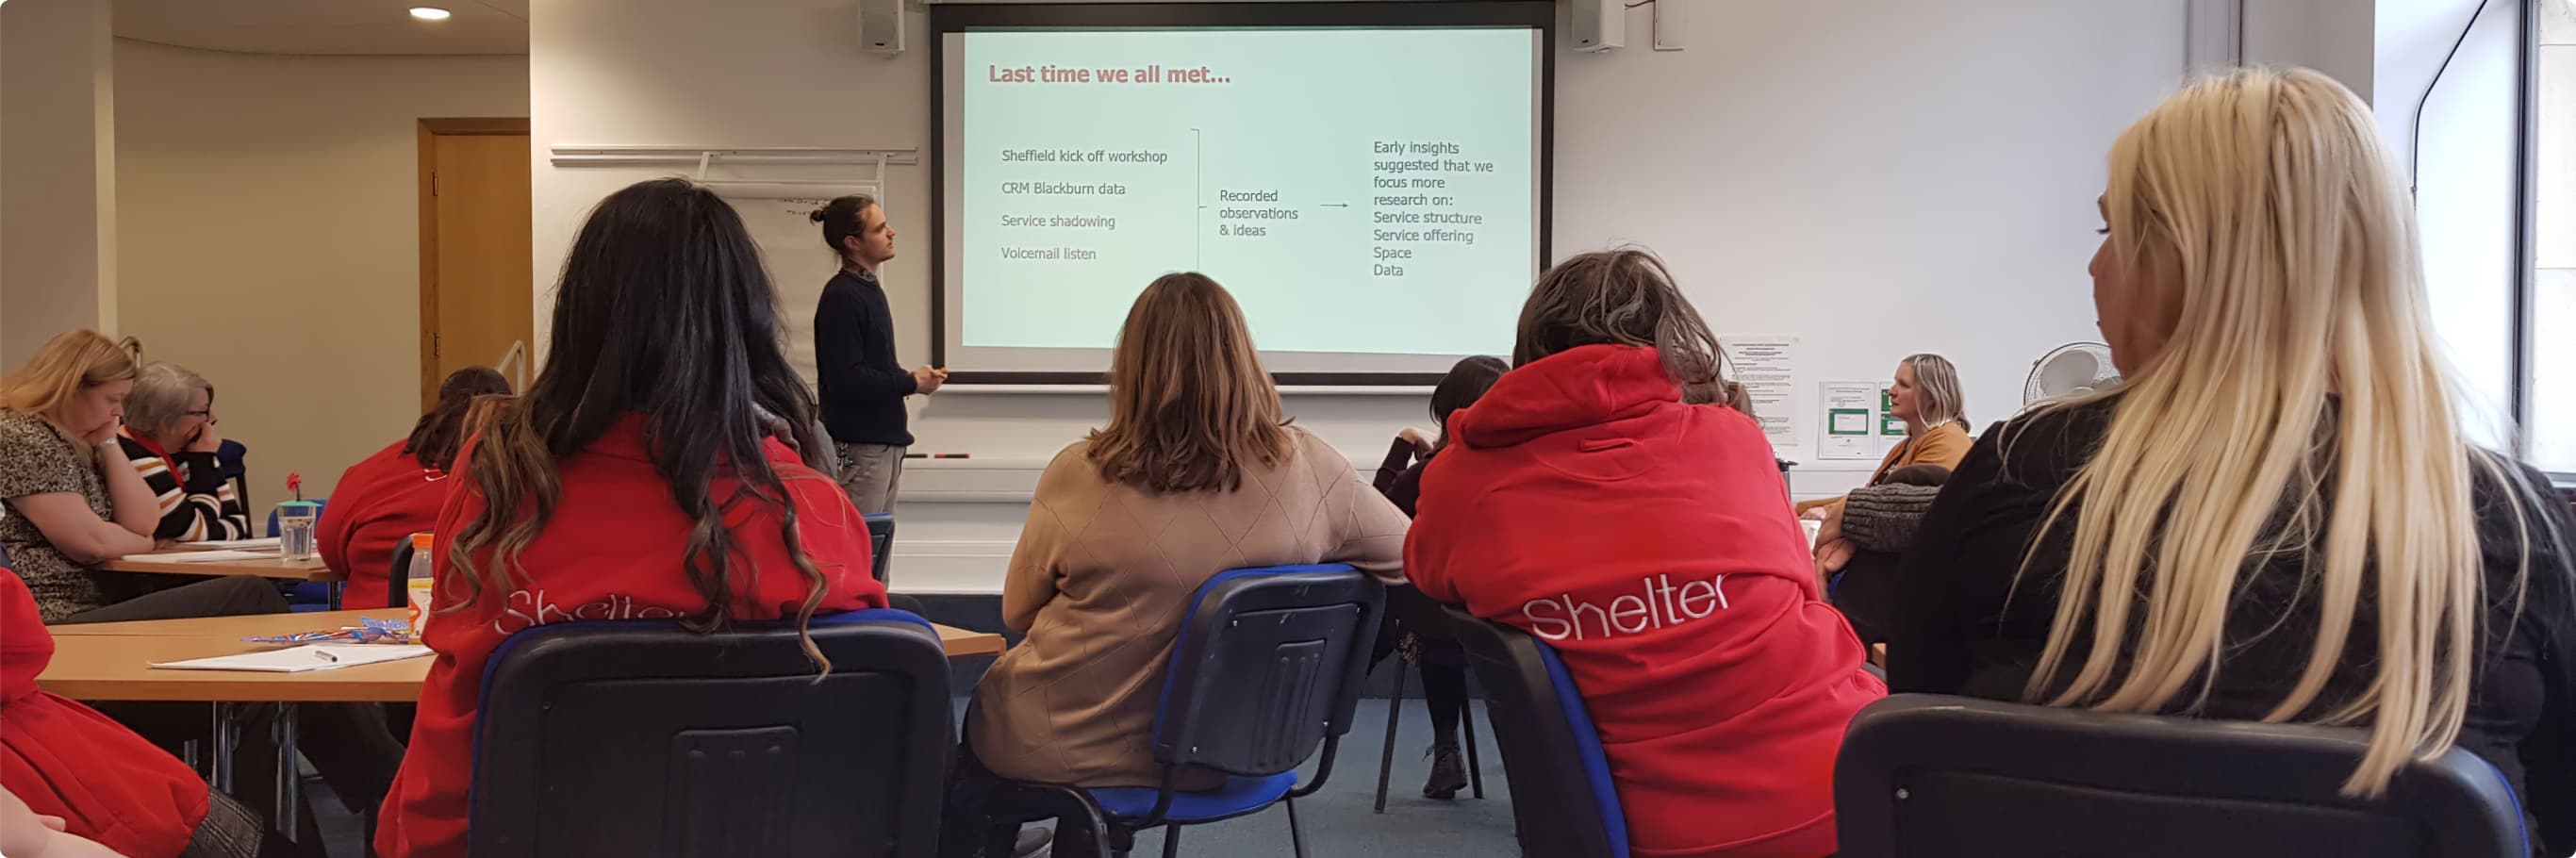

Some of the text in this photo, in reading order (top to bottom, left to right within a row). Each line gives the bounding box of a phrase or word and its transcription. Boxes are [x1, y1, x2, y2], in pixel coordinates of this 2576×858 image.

[990, 65, 1230, 84] Last time we all met...
[1375, 140, 1459, 157] Early insights
[1002, 149, 1167, 165] Sheffield kick off workshop
[1374, 158, 1494, 173] suggested that we
[1002, 182, 1126, 194] CRM Blackburn data
[1374, 176, 1445, 188] focus more
[1220, 190, 1278, 202] Recorded
[1375, 193, 1453, 206] research on:
[1220, 206, 1297, 219] observations
[1374, 211, 1482, 224] Service structure
[1001, 215, 1115, 230] Service shadowing
[1220, 223, 1265, 236] & ideas
[1374, 229, 1473, 244] Service offering
[1001, 247, 1096, 259] Voicemail listen
[1374, 247, 1412, 261] Space
[1374, 264, 1403, 276] Data
[1523, 573, 1729, 640] Shelter
